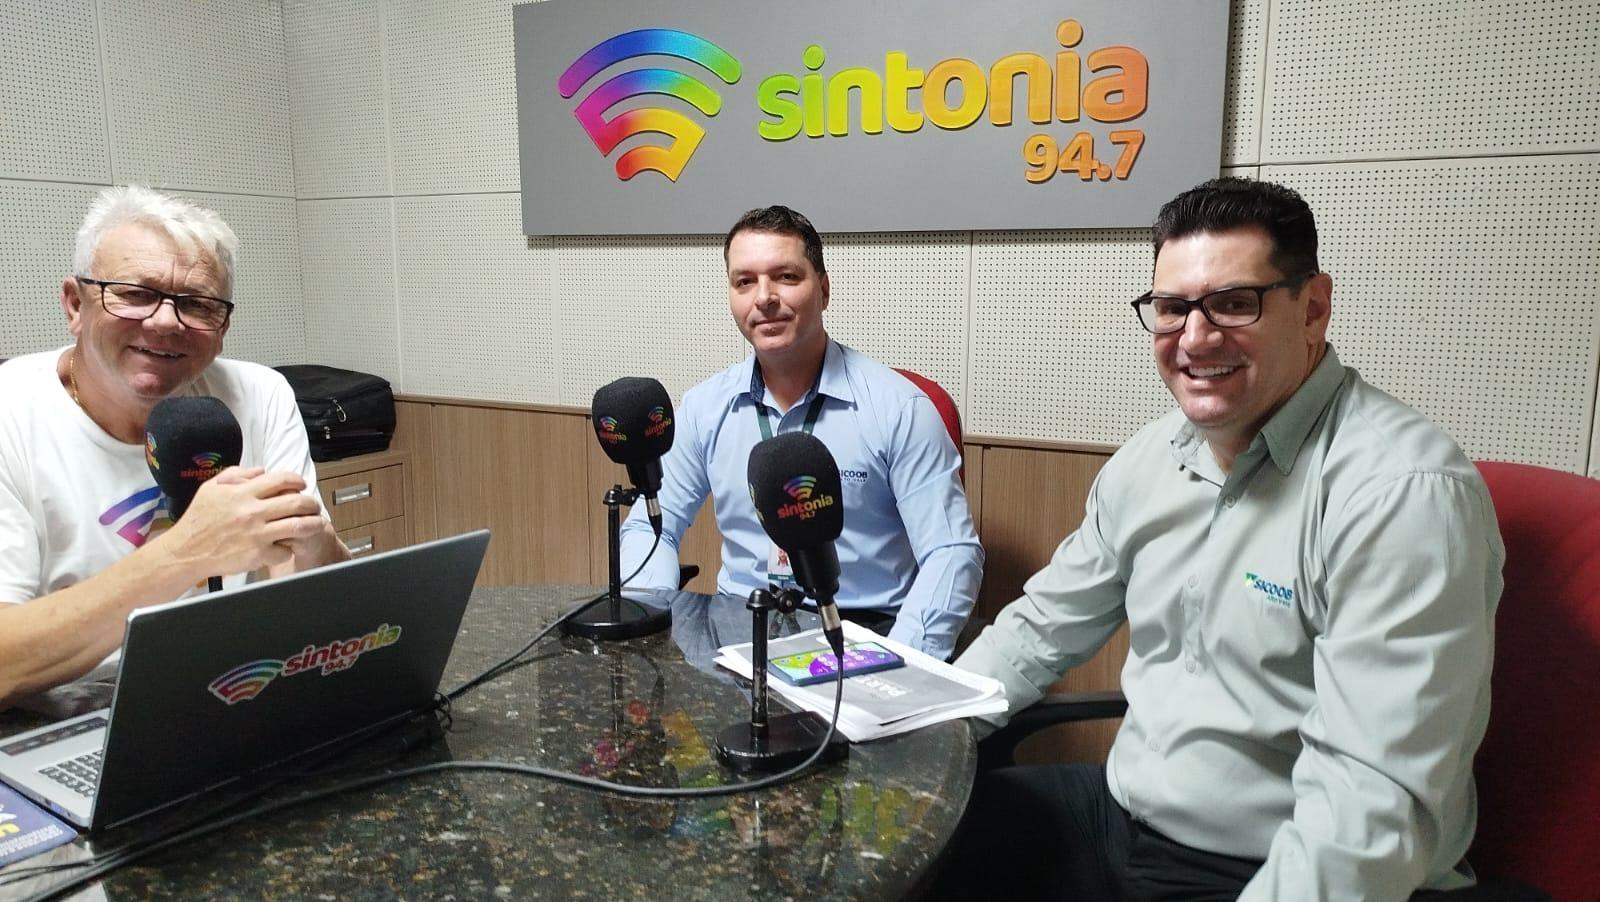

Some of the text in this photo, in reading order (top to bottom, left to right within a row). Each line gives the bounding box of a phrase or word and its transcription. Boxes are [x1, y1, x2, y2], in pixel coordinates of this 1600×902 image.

[757, 19, 1150, 141] sintonia
[1023, 129, 1145, 184] 94.7
[840, 469, 868, 479] ICOOB
[777, 494, 834, 519] sintonia
[1254, 579, 1293, 601] SICOOB
[282, 623, 402, 676] sintonia
